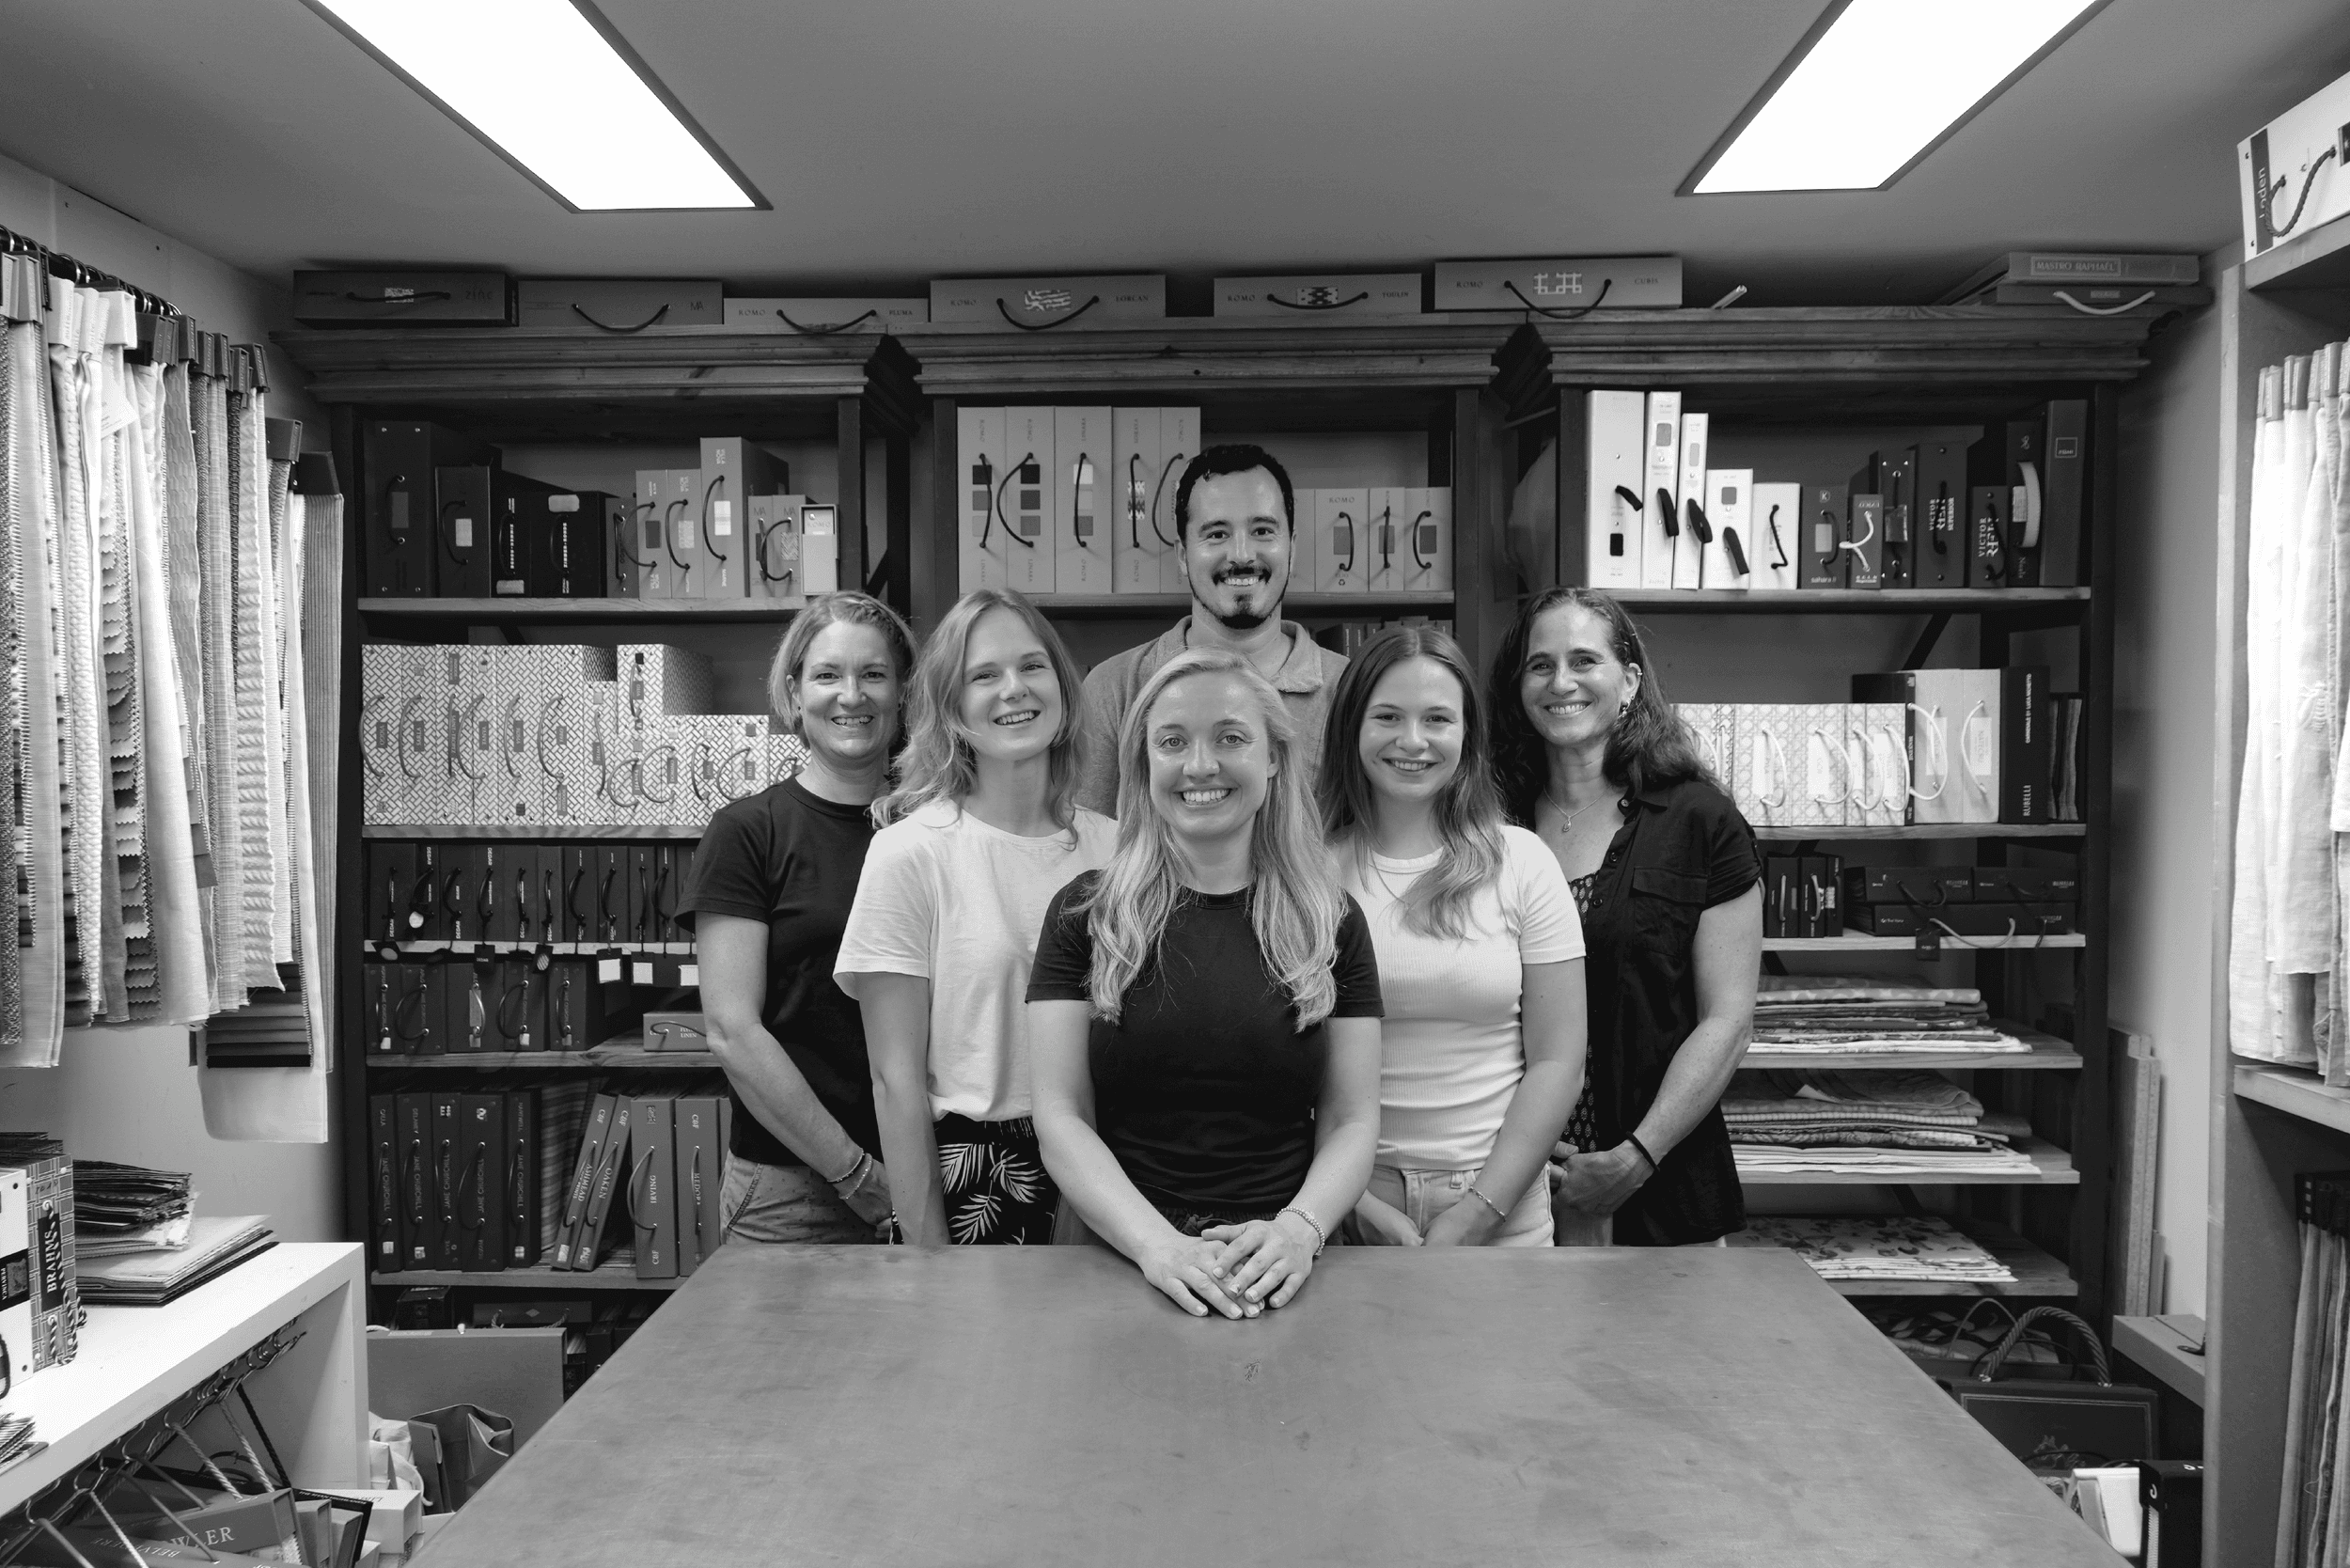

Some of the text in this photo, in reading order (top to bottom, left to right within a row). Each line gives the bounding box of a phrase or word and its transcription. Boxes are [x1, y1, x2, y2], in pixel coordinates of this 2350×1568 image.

[2036, 261, 2072, 271] MASTRO
[1977, 517, 1985, 557] VICTOR
[2023, 785, 2031, 816] RUBELLI
[383, 1174, 391, 1211] CHURCHILL
[415, 1173, 423, 1210] CHURCHILL
[577, 1164, 593, 1202] ASHMEAD
[598, 1168, 612, 1200] OAKEN
[44, 1231, 58, 1293] BRAHMS
